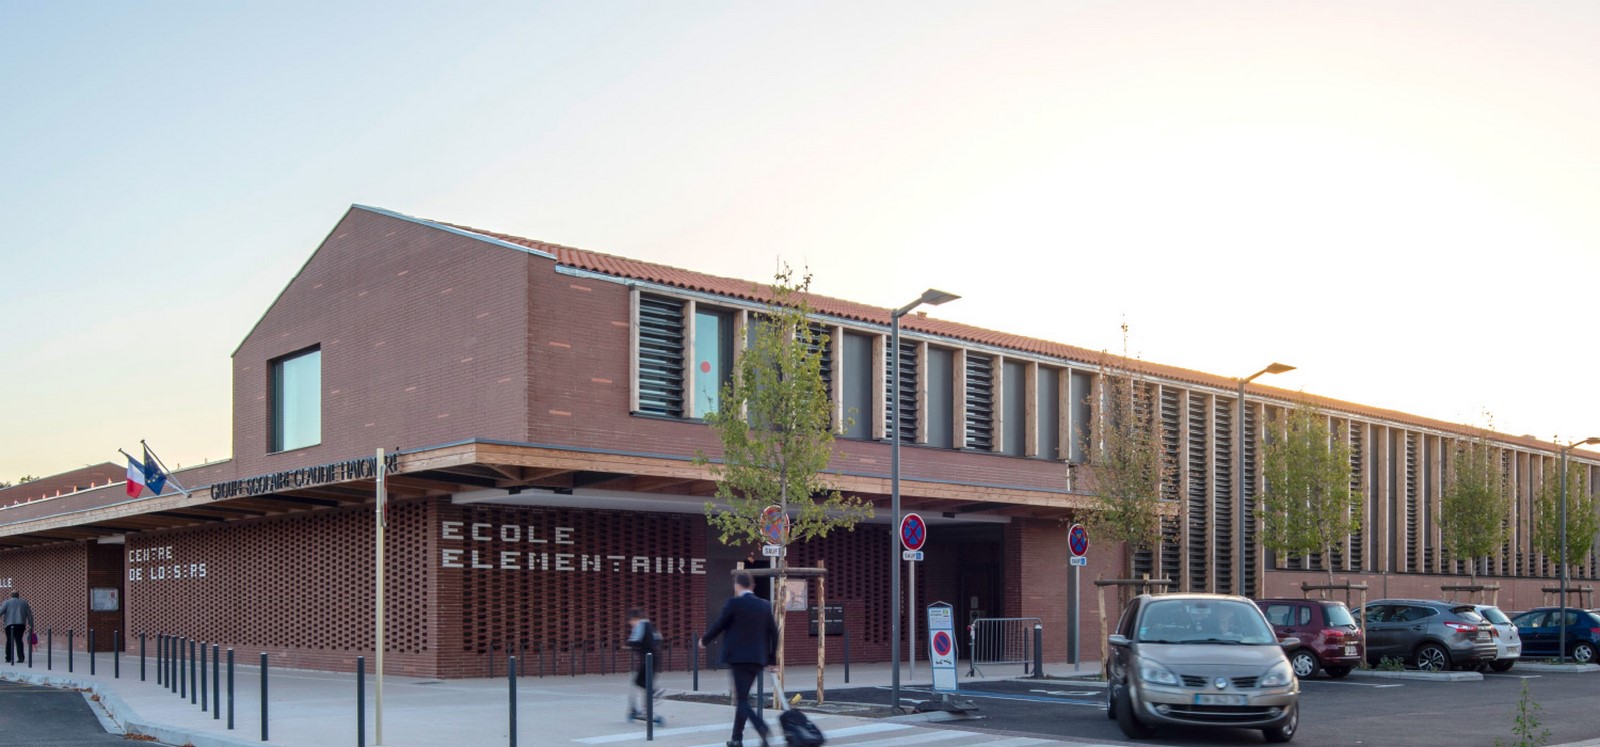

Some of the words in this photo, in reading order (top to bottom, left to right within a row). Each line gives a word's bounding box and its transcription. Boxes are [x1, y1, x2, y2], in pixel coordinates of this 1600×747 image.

[341, 446, 399, 480] HAIGNRÉ
[442, 521, 575, 545] ECOLE
[129, 546, 173, 562] CENTRE
[442, 549, 707, 575] ELEMENTAIRE
[129, 568, 142, 580] DE
[150, 563, 206, 580] LOISIRS
